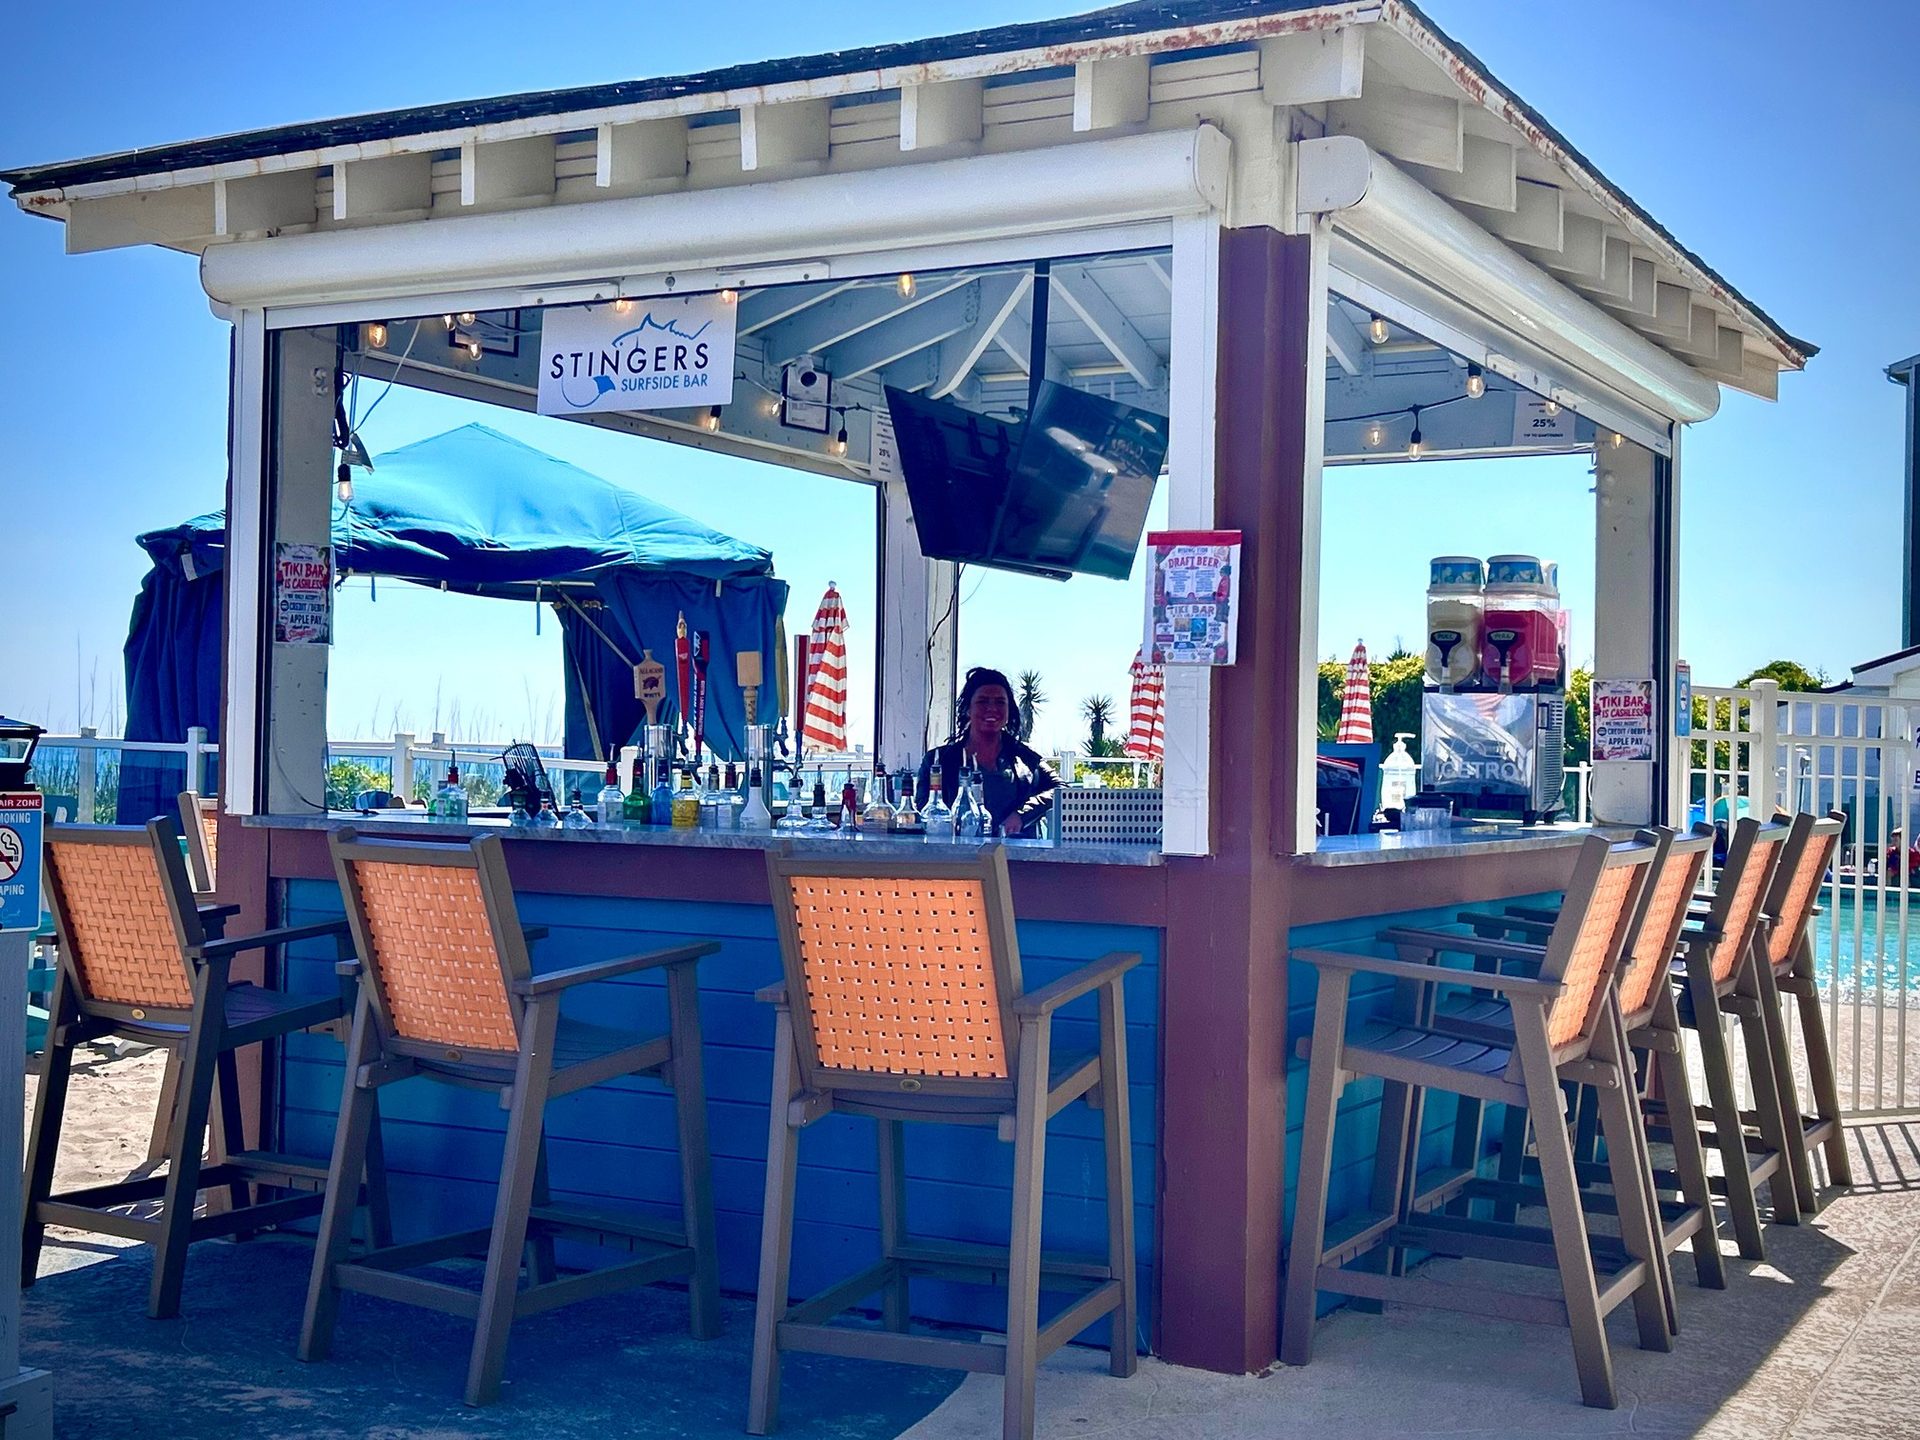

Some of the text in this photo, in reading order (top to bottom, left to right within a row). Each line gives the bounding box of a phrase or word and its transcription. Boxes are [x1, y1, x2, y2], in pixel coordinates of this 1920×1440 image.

[550, 343, 709, 379] STINGERS
[621, 373, 708, 392] SURFSIDE BAR
[1532, 418, 1556, 428] 25%
[1168, 556, 1219, 569] DRAFT BEER
[282, 562, 324, 578] TIKI BAR
[285, 578, 323, 590] IS CASHLESS
[1167, 605, 1214, 615] TIKI BAR
[290, 614, 322, 625] APPLE PAY
[1599, 695, 1644, 708] TIKI BAR
[1602, 707, 1644, 718] IS CASHLESS
[1608, 737, 1643, 745] APPLE PAY
[1435, 761, 1517, 779] ICETRO
[0, 799, 40, 807] AIR ZONE
[0, 812, 31, 824] MOKING
[0, 884, 25, 896] APING
